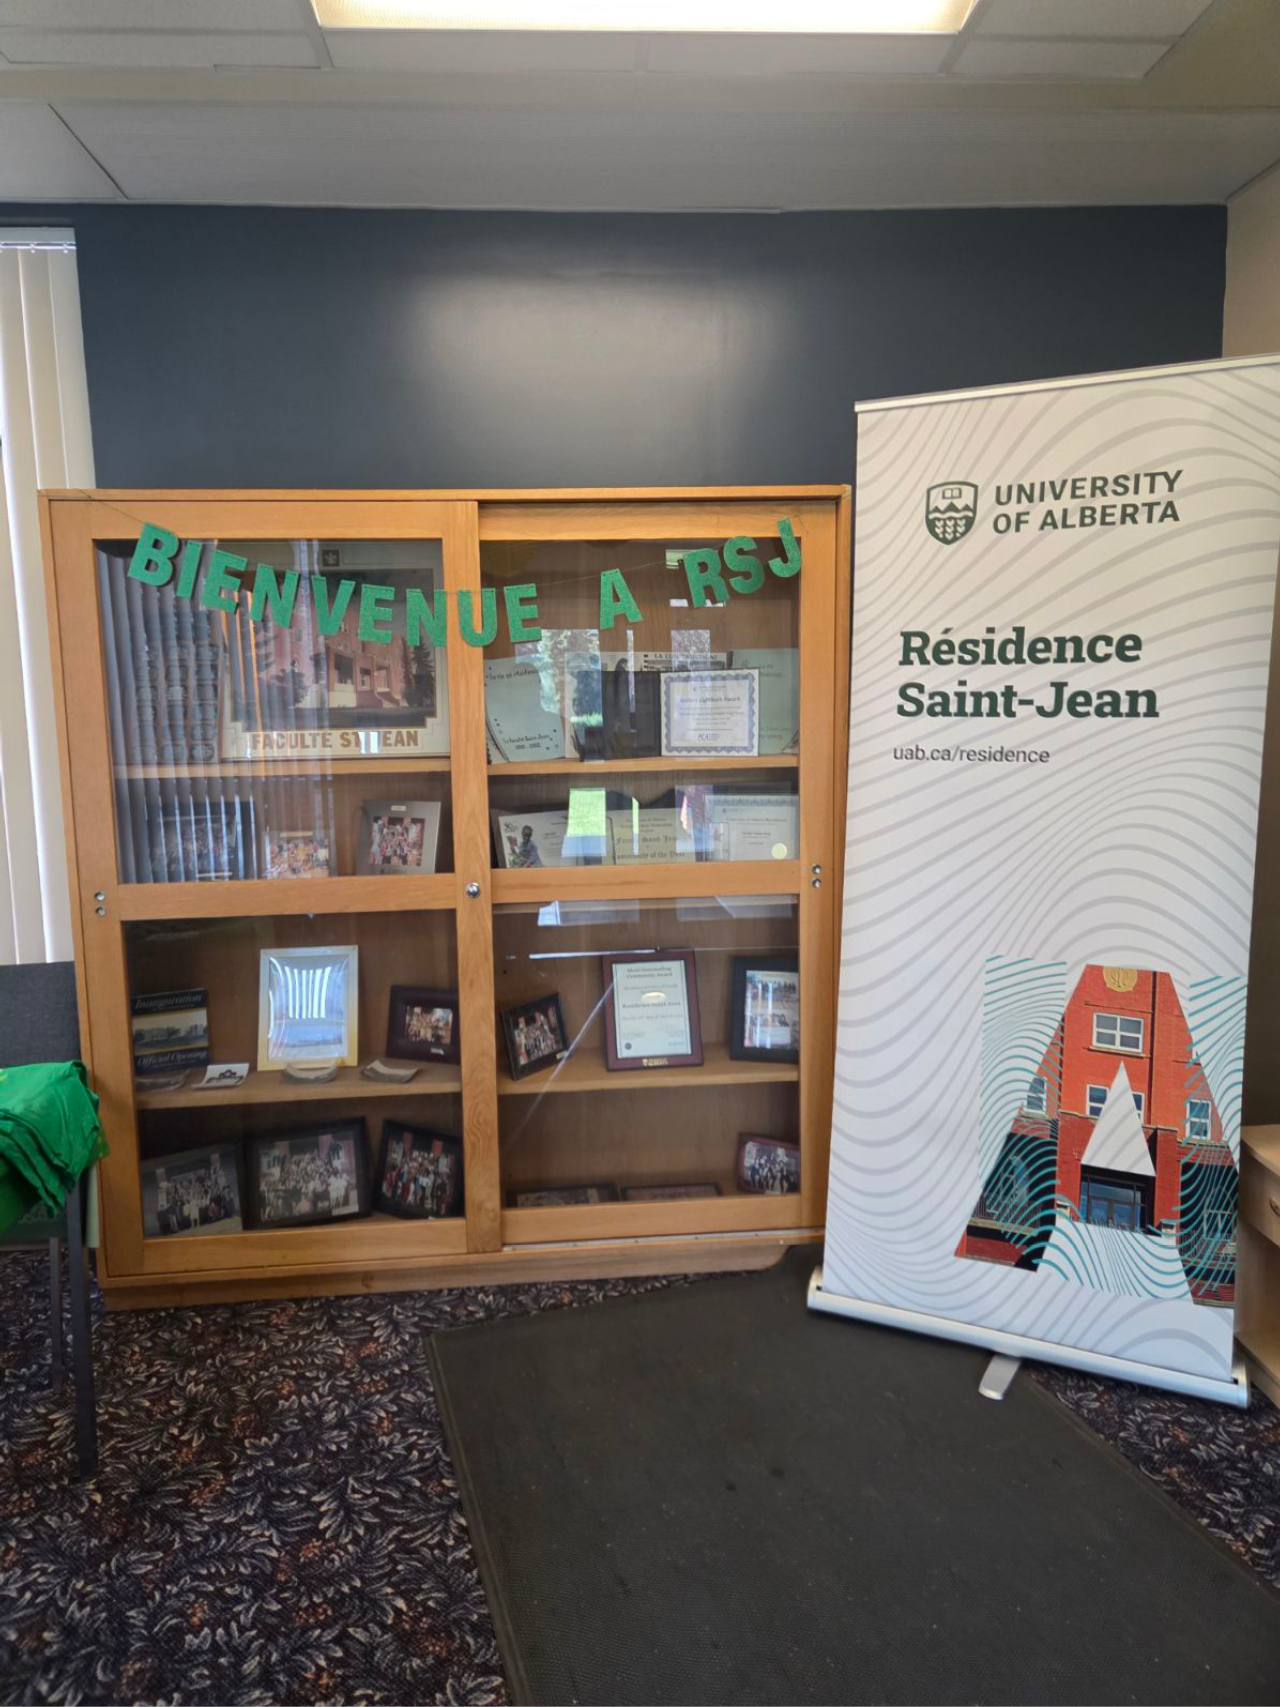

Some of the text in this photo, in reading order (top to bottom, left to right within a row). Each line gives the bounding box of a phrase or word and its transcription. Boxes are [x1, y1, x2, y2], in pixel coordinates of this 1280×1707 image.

[995, 470, 1183, 506] UNIVERSITY
[993, 500, 1180, 534] OF ALBERTA
[127, 517, 802, 648] BIENVENUE A RSJ
[898, 626, 1142, 666] Résidence
[896, 679, 1160, 718] Saint-Jean
[892, 744, 1050, 763] uab.ca/residence
